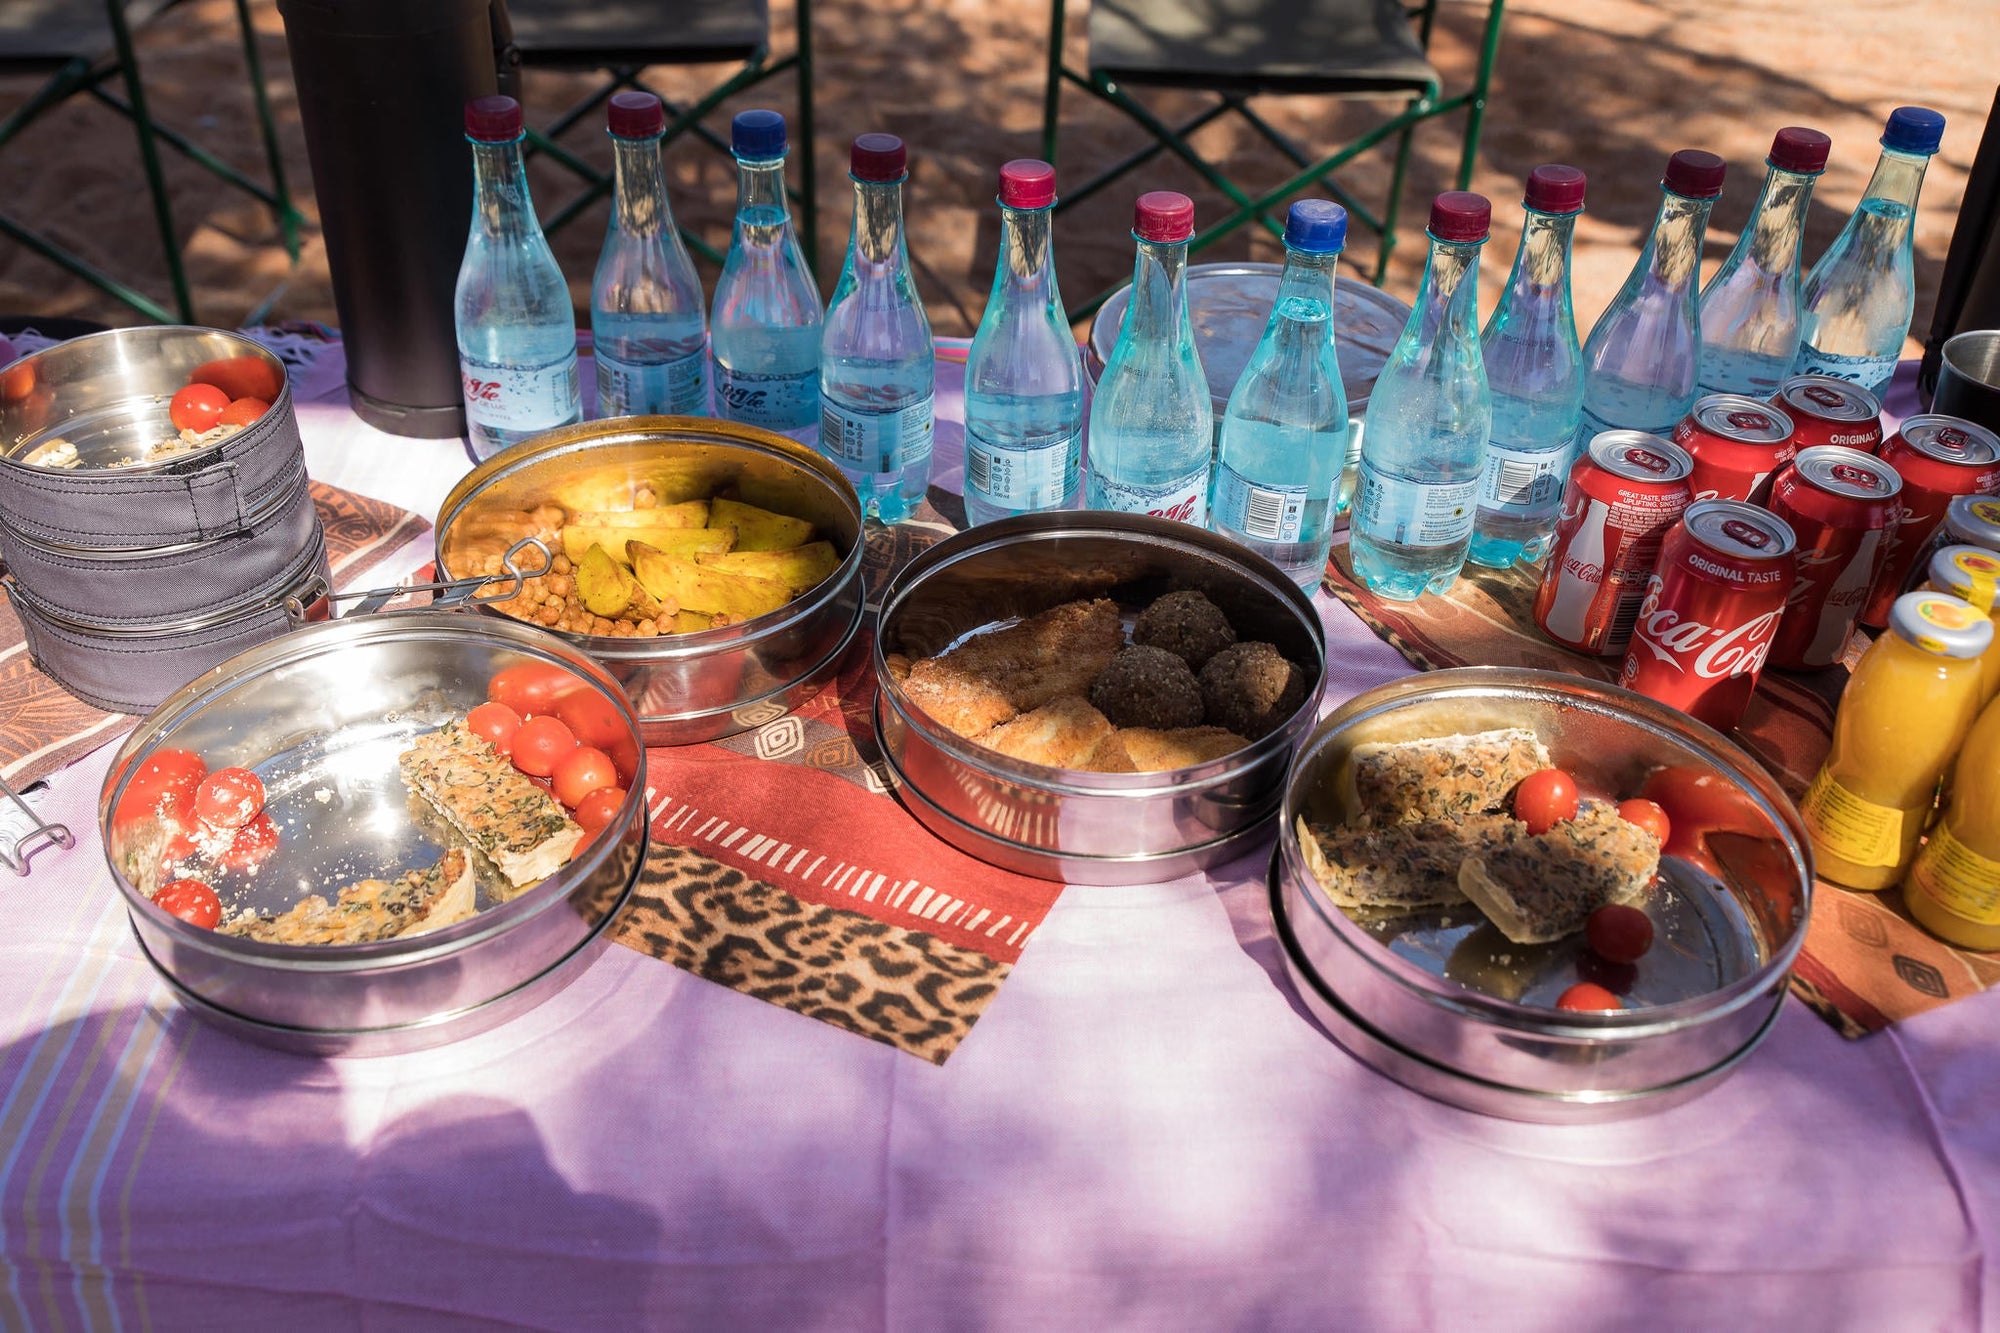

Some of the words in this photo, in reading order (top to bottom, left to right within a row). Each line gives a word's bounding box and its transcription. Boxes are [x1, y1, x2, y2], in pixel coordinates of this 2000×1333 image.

[1830, 431, 1875, 445] ORIGINAL
[1618, 489, 1639, 499] GREAT
[1688, 553, 1745, 583] ORIGINAL
[1747, 569, 1781, 584] TASTE
